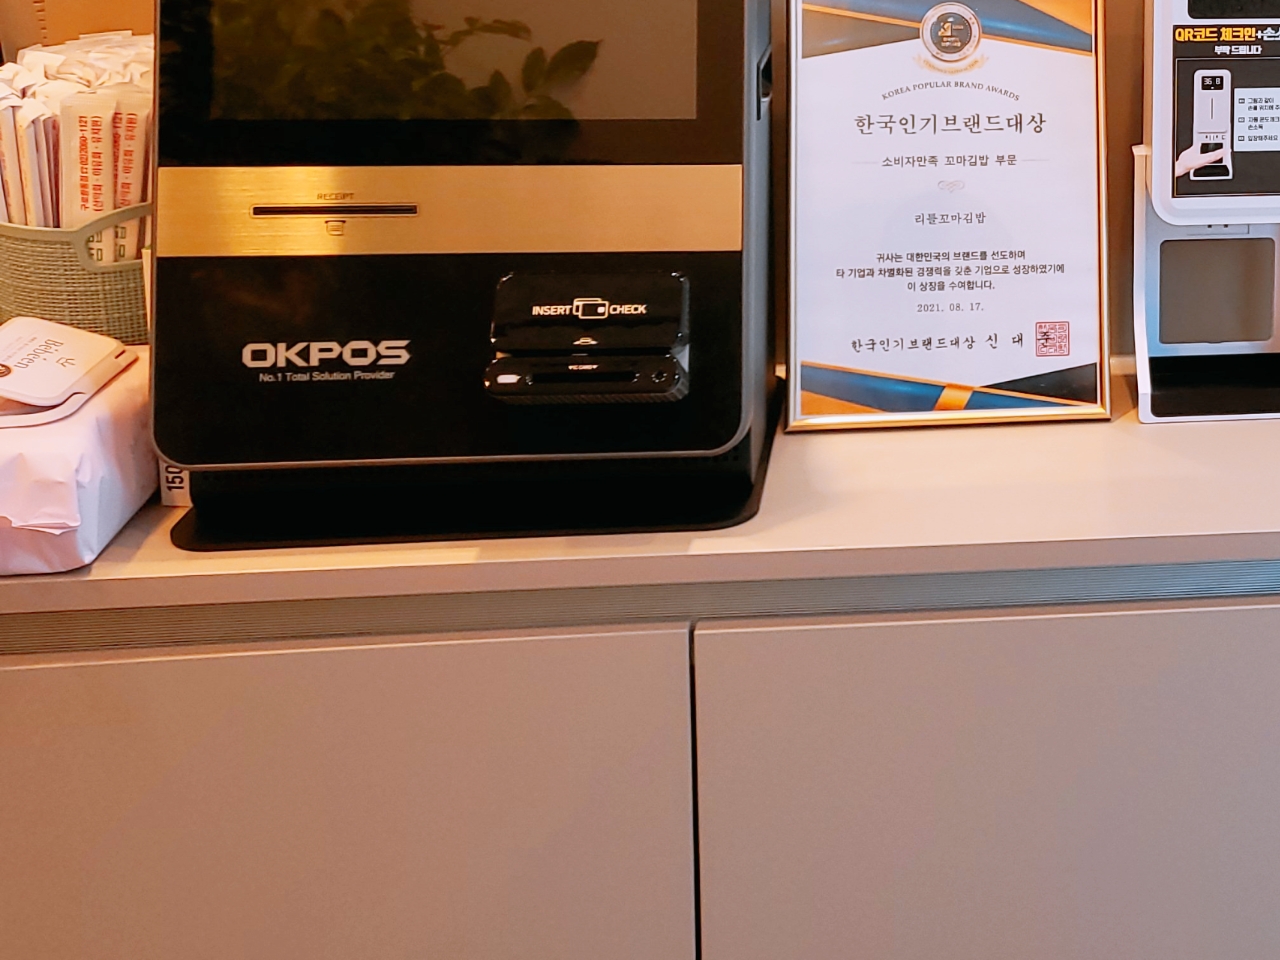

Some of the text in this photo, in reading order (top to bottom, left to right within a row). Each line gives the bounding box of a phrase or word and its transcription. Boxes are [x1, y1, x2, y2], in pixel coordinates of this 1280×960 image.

[1175, 28, 1218, 42] QR코드
[881, 80, 1020, 102] KOREA POPULAR BRAND AWARDS
[855, 113, 1046, 134] 한국인기브랜드대상
[882, 155, 1017, 167] 소비자만족 꼬마김밥 부문
[317, 192, 355, 200] RECEIPT
[915, 212, 986, 225] 리틀꼬마김밥
[877, 251, 1025, 263] 귀사는 대한민국의 브랜드를 선도하며
[836, 269, 845, 278] 타
[848, 268, 874, 278] 기업과
[878, 268, 912, 277] 차별화된
[917, 266, 951, 277] 경쟁력을
[975, 265, 1010, 275] 기업으로
[1013, 264, 1064, 274] 성장하였기에
[908, 282, 915, 291] 이
[949, 280, 996, 290] 수여합니다.
[532, 304, 648, 316] INSERT CHECK
[917, 303, 985, 312] 2021. 08. 17.
[851, 336, 975, 353] 한국인기브랜드대상
[986, 333, 998, 348] 신
[1012, 333, 1024, 348] 대
[242, 340, 411, 367] OKPOS
[259, 369, 396, 382] No.1 Total Solution Provider
